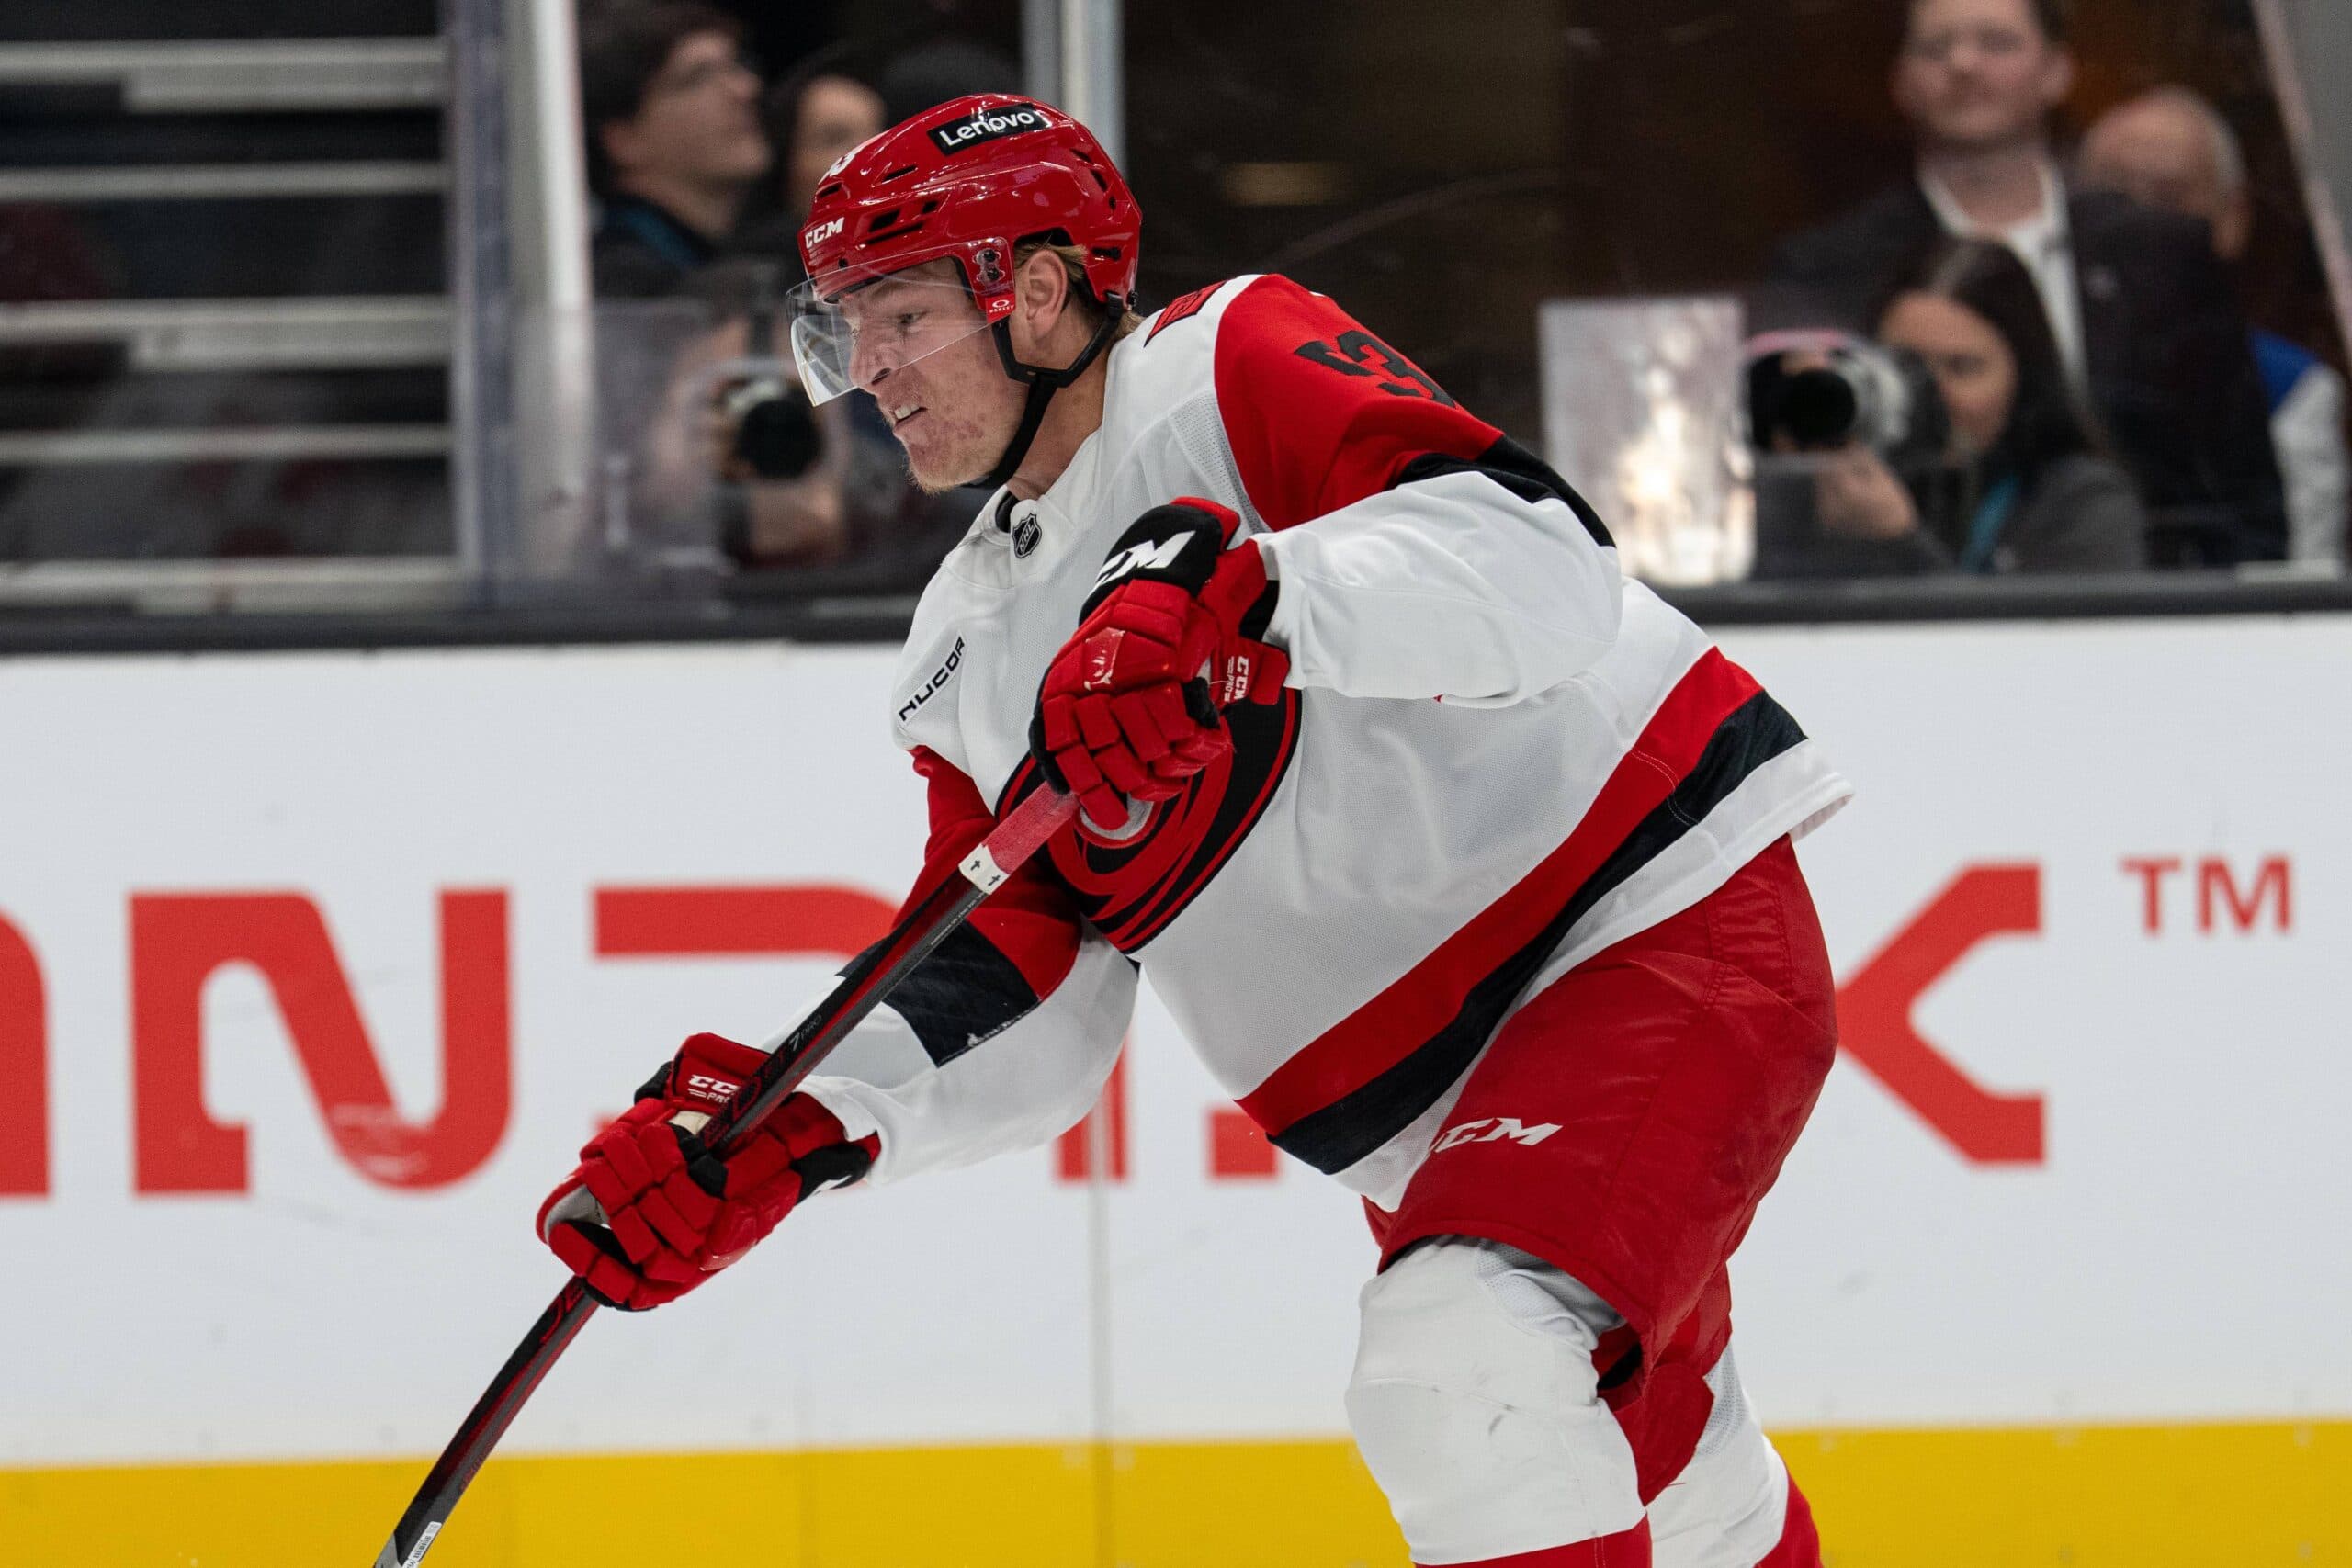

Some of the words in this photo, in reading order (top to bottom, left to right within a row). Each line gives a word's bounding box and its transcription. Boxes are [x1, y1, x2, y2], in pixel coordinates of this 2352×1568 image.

[939, 112, 1035, 146] Lenovo
[805, 217, 845, 249] CCM
[1087, 530, 1196, 599] CM
[899, 636, 965, 721] NUCOR
[1233, 655, 1250, 700] CCM
[2120, 853, 2295, 935] TM
[688, 1074, 741, 1094] CC
[1430, 1117, 1564, 1154] CM
